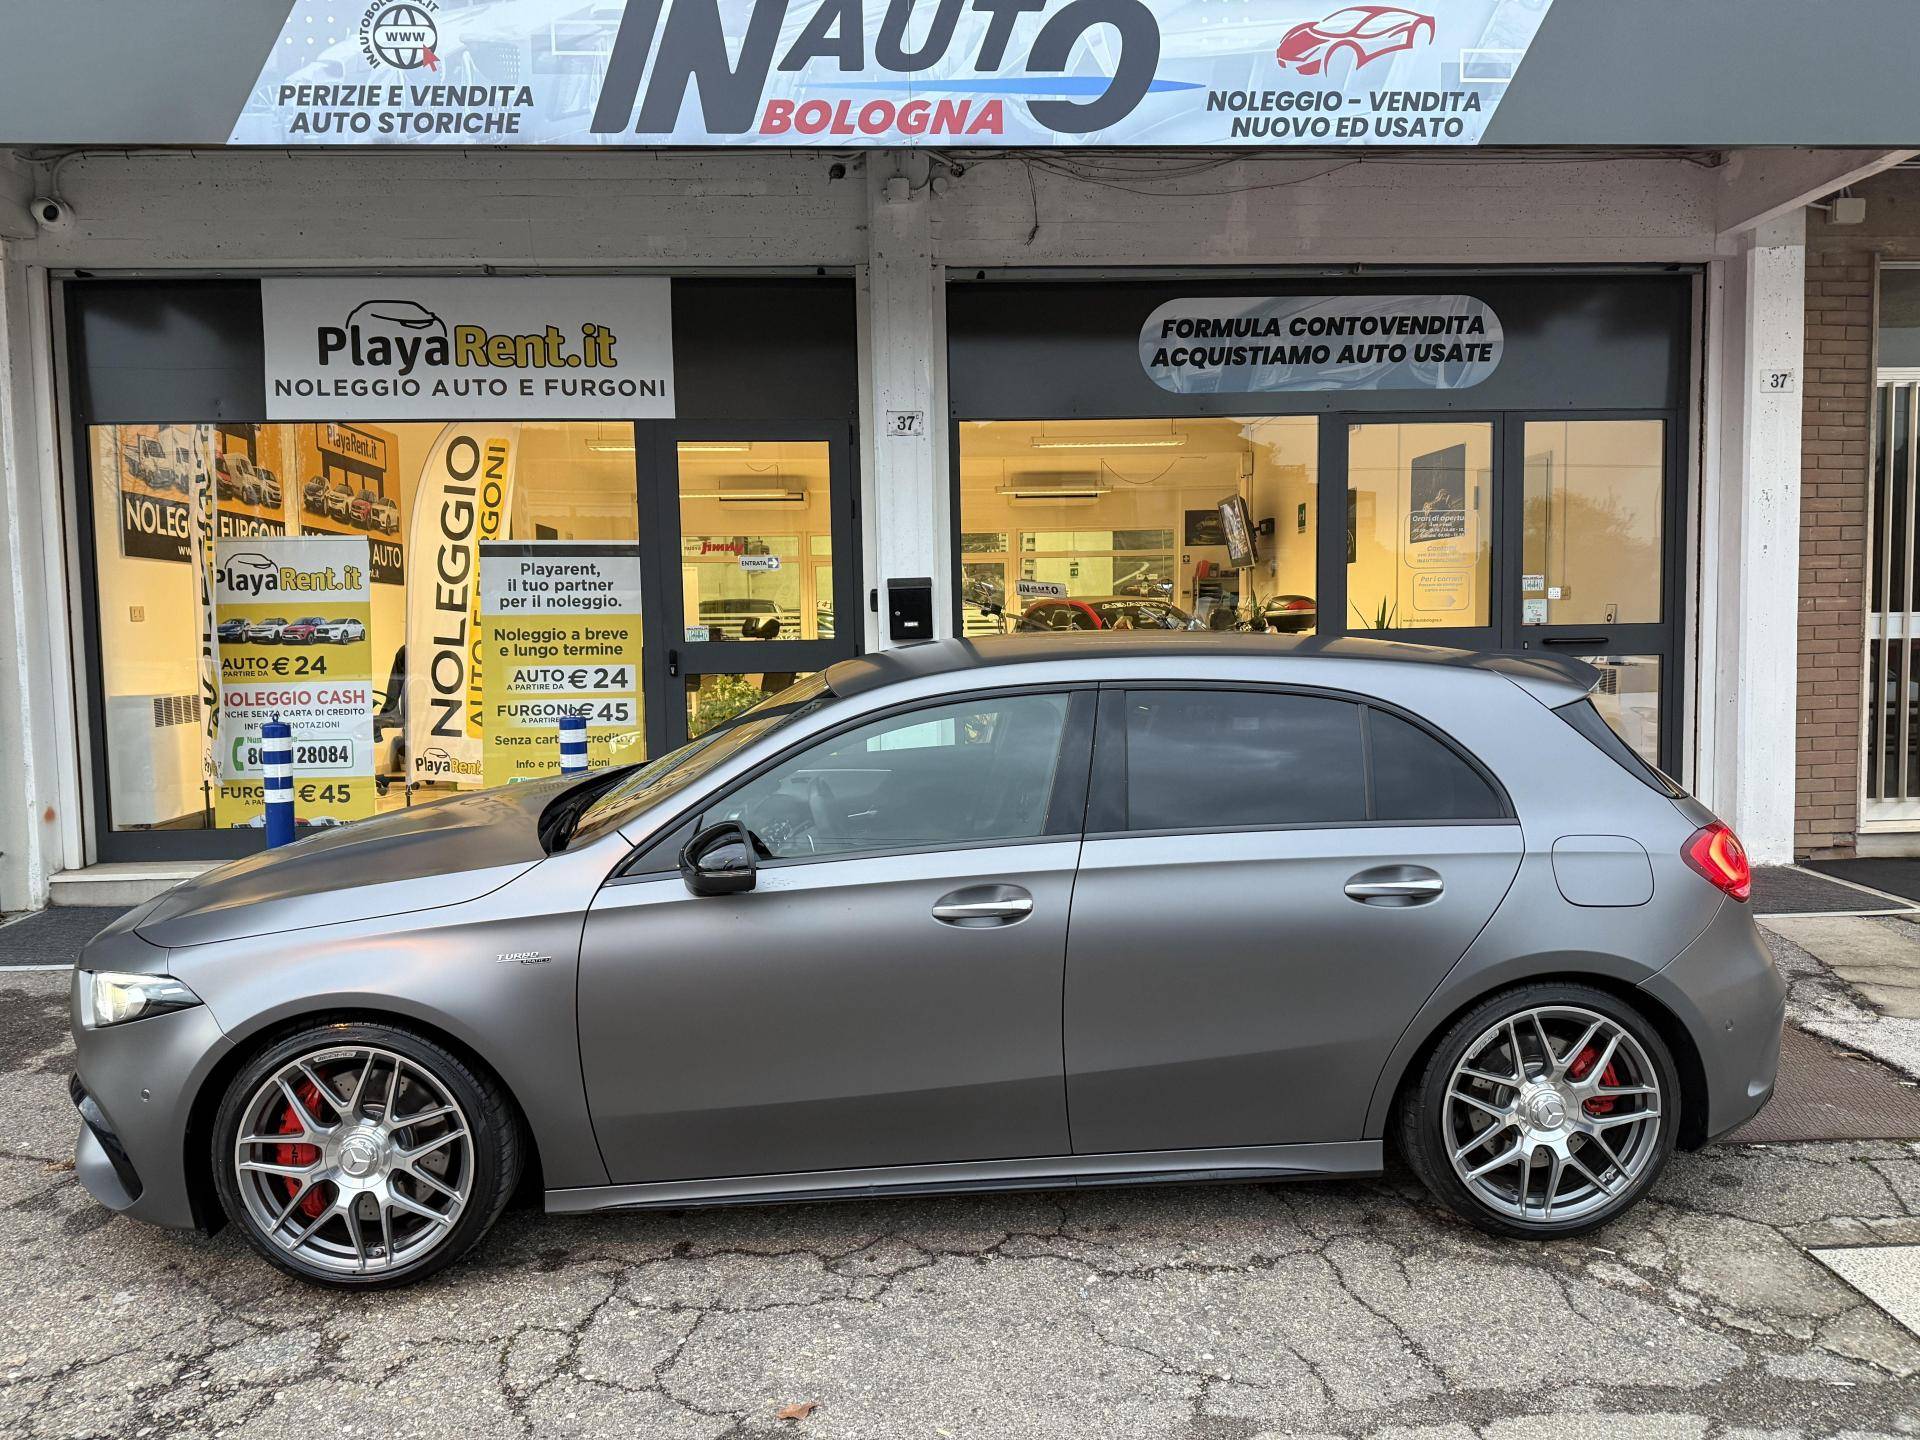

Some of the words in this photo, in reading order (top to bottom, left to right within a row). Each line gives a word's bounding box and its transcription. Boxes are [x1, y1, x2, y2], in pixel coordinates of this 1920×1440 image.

[360, 0, 439, 69] INAUTOBOL.IT
[278, 85, 384, 106] PERIZIE
[387, 86, 402, 106] E
[410, 85, 534, 106] VENDITA
[1206, 91, 1343, 112] NOLEGGIO
[1369, 91, 1482, 112] VENDITA
[289, 112, 371, 133] AUTO
[378, 112, 521, 134] STORICHE
[759, 99, 1004, 135] BOLOGNA
[1231, 117, 1330, 138] NUOVO
[1335, 117, 1369, 138] ED
[1374, 117, 1464, 138] USATO
[1161, 318, 1281, 339] FORMULA
[1288, 315, 1485, 337] CONTOVENDITA
[317, 323, 618, 375] PlayaRent.it
[1150, 345, 1330, 369] ACQUISTIAMO
[1336, 344, 1407, 364] AUTO
[1413, 343, 1493, 363] USATE
[274, 378, 421, 397] NOLEGGIO
[431, 378, 508, 397] AUTO
[519, 378, 535, 397] E
[544, 378, 666, 397] FURGONI
[327, 424, 378, 461] PlayaRent.it
[480, 445, 506, 541] GONI
[125, 497, 192, 540] NOLEG
[372, 544, 402, 568] AUTO
[520, 562, 601, 578] Playarent,
[430, 435, 481, 738] NOLEGGIO
[507, 579, 518, 592] il
[522, 580, 550, 592] tuo
[554, 580, 614, 595] partner
[500, 597, 528, 610] per
[532, 595, 544, 608] il
[546, 595, 622, 610] noleggio.
[494, 628, 567, 643] Noleggio
[571, 630, 581, 641] a
[585, 628, 629, 641] breve
[499, 646, 509, 656] e
[513, 644, 559, 659] lungo
[563, 644, 623, 656] termine
[222, 657, 268, 670] AUTO
[294, 655, 327, 675] 24
[513, 669, 565, 683] AUTO
[593, 667, 628, 689] 24
[515, 683, 550, 691] PARTIRE
[317, 689, 365, 705] CASH
[224, 710, 249, 719] NCHE
[283, 709, 312, 717] CARTA
[315, 708, 324, 717] DI
[327, 708, 365, 716] CREDITO
[596, 702, 629, 721] 45
[287, 721, 340, 730] NOTAZIONI
[494, 735, 532, 746] Senza
[535, 735, 560, 745] cart
[415, 757, 483, 775] PlayaRent.
[516, 759, 535, 769] Info
[538, 760, 545, 769] e
[220, 787, 265, 799] FURG
[319, 783, 351, 804] 45
